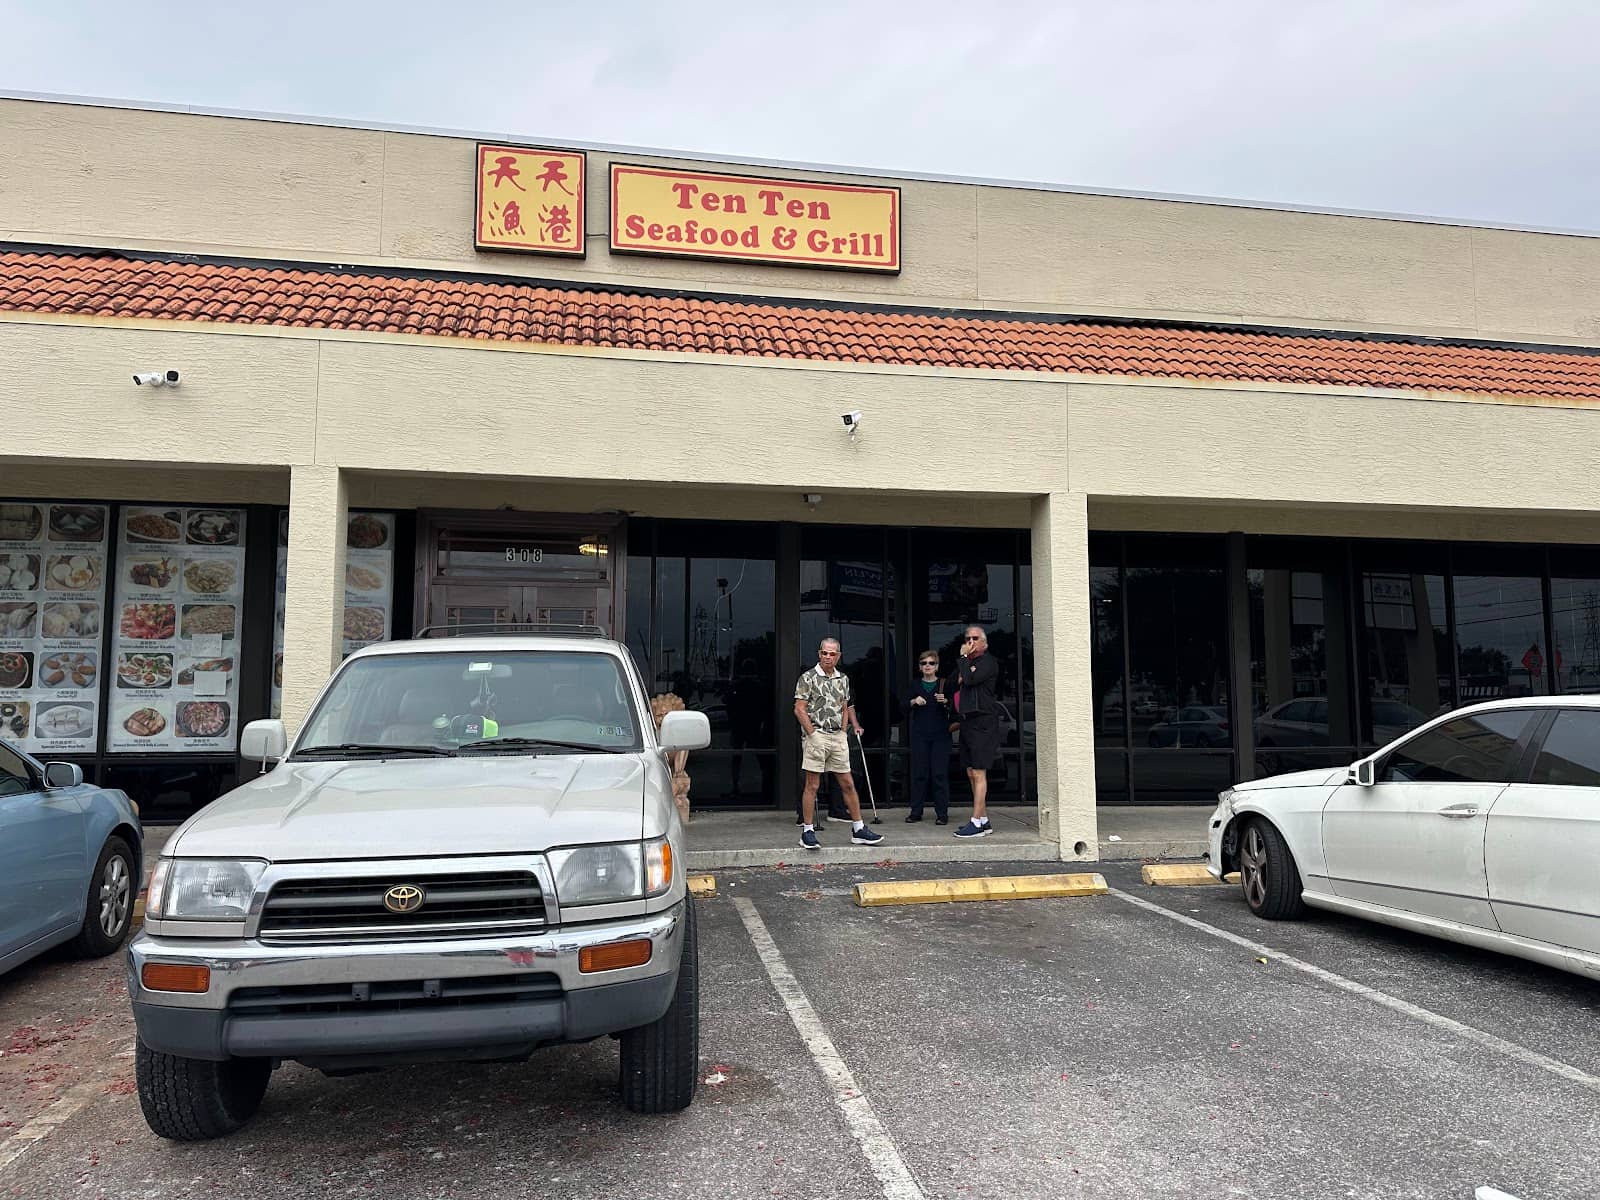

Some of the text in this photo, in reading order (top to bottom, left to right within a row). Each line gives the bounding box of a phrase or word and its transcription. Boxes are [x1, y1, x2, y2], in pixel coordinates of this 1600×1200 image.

[487, 156, 574, 196] 天天
[672, 182, 831, 220] Ten Ten
[488, 200, 572, 243] 漁港
[625, 214, 884, 256] Seafood & Grill
[506, 547, 542, 562] 308
